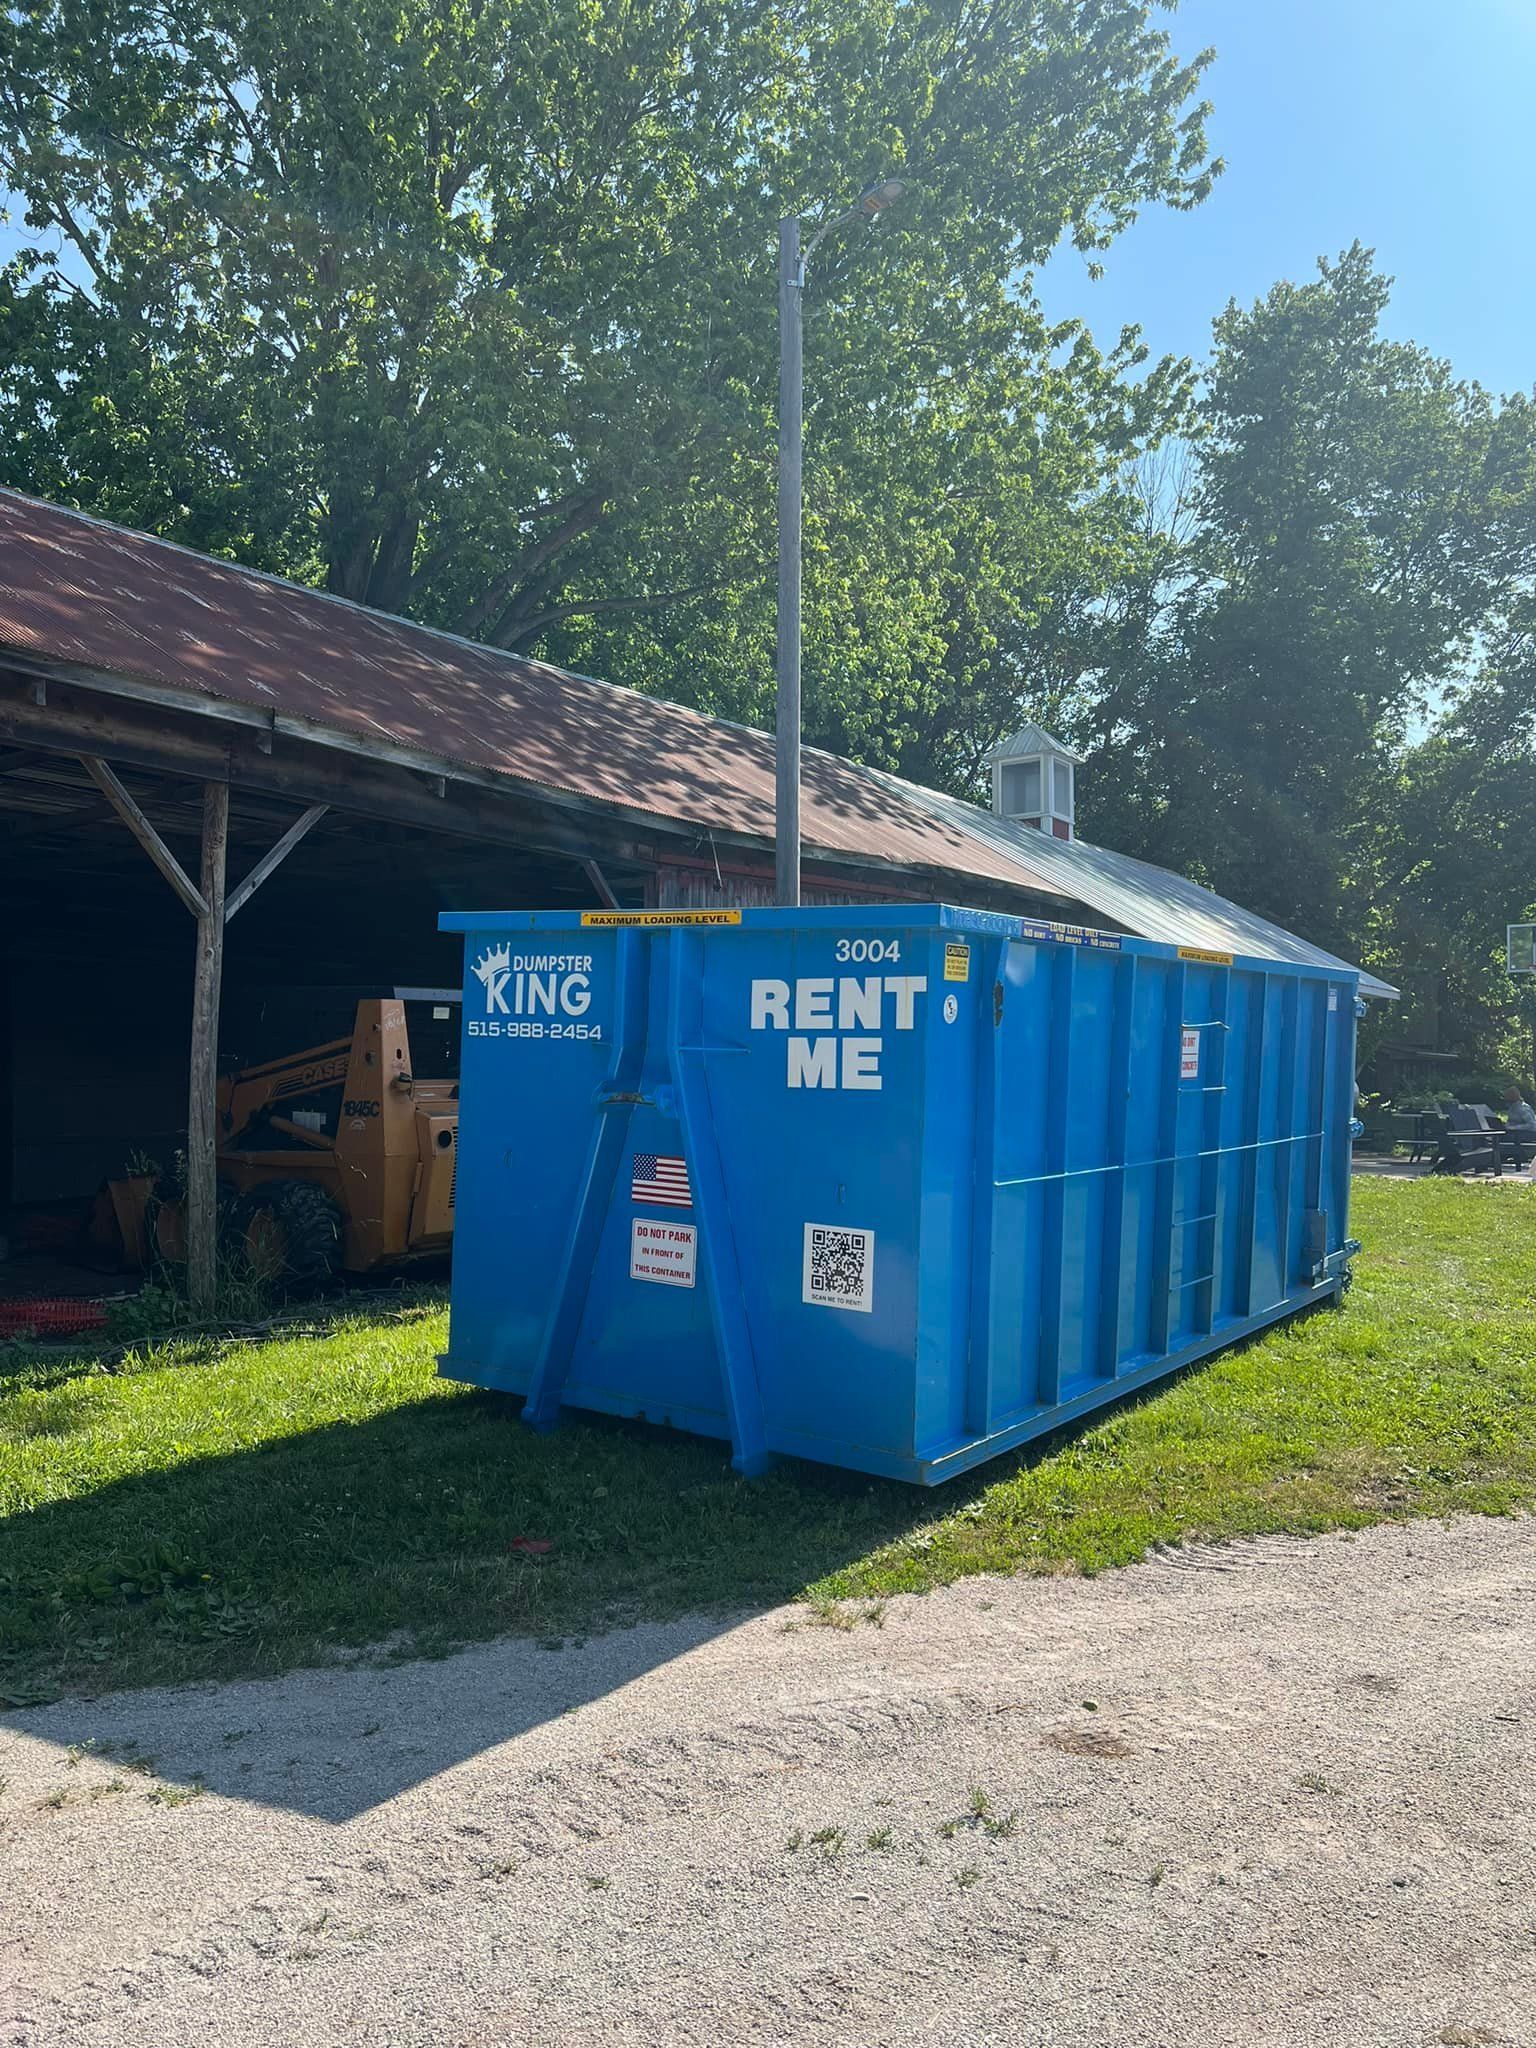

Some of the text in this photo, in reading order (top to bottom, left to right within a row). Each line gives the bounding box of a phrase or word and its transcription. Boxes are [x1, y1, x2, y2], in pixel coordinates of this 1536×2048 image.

[590, 914, 730, 925] MAXIMUM LOADING LEVEL
[1023, 928, 1033, 937] NO
[1055, 933, 1064, 942] NO
[1090, 938, 1099, 946] NO
[835, 939, 901, 963] 3004
[512, 955, 593, 973] DUMPSTER
[486, 972, 592, 1017] KING
[751, 976, 928, 1031] RENT
[467, 1021, 602, 1041] 515-988-2454
[787, 1036, 883, 1090] ME
[303, 1059, 348, 1086] CASE
[343, 1100, 380, 1117] 1845C
[637, 1226, 692, 1243] DO NOT PARK
[642, 1247, 684, 1260] IN FRONT OF
[635, 1264, 691, 1279] THIS CONTAINER
[811, 1294, 826, 1302] SCAN
